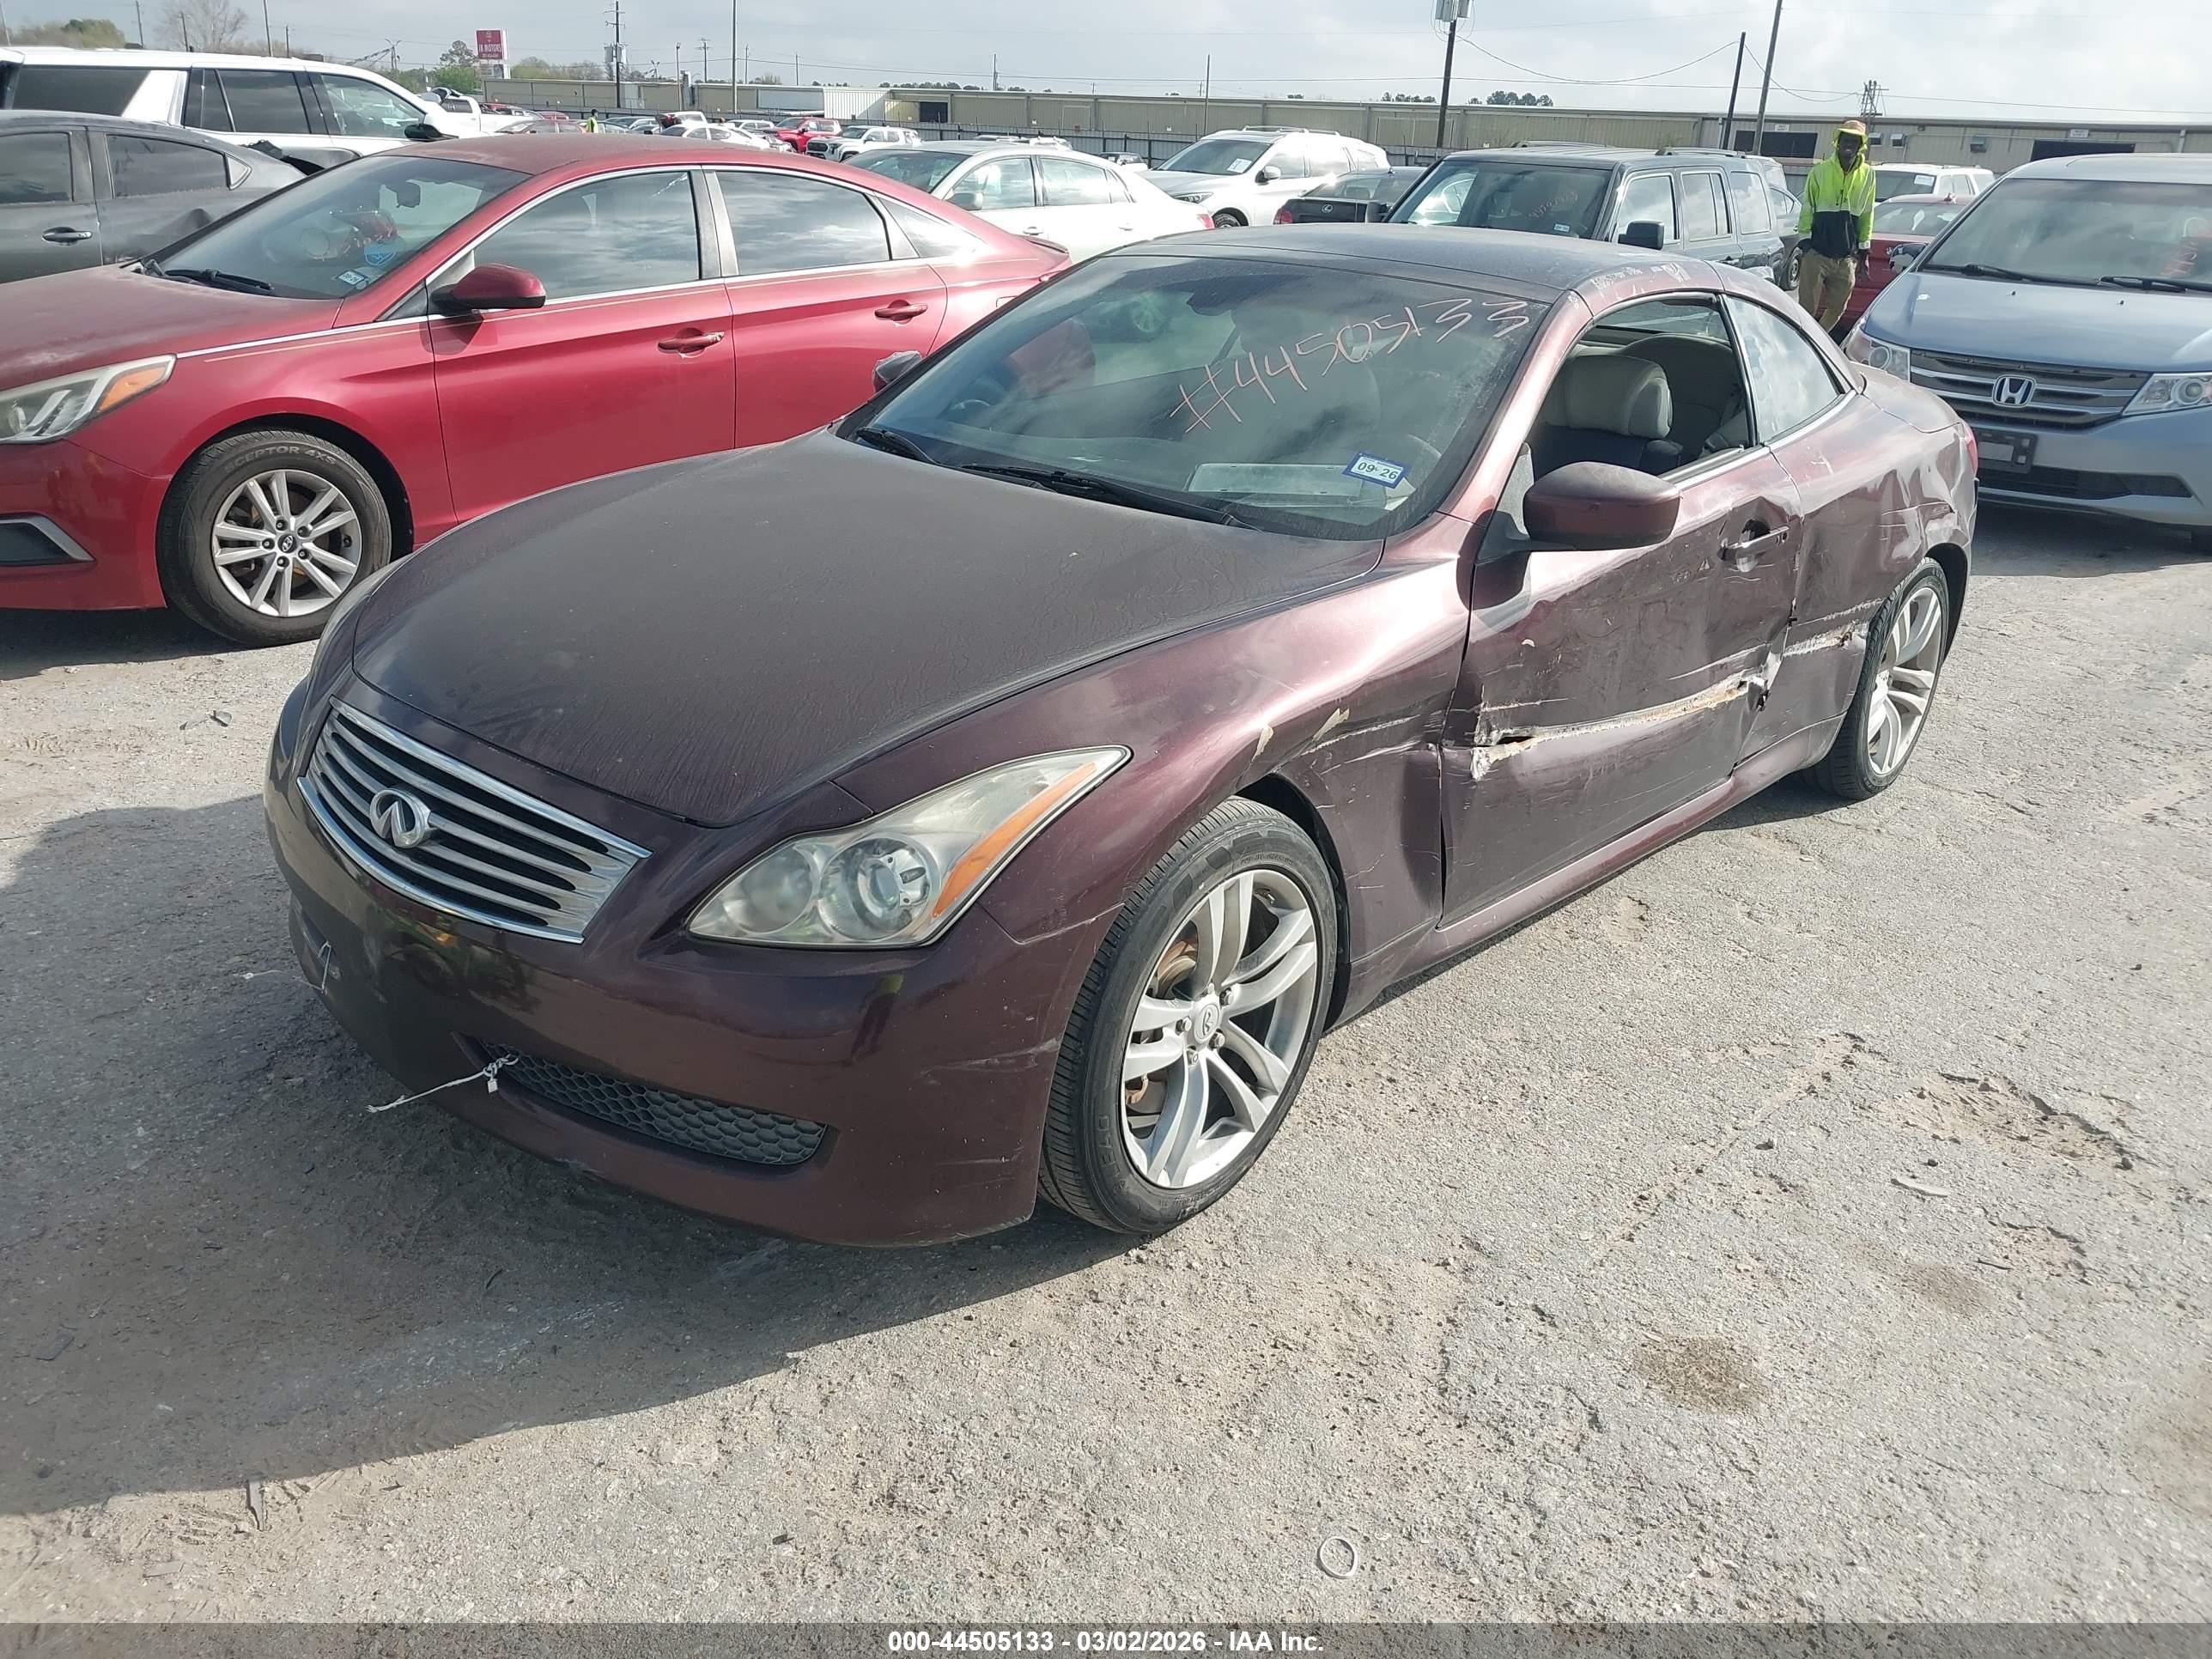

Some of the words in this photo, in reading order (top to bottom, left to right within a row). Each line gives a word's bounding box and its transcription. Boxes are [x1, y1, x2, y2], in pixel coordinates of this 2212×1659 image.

[1170, 298, 1529, 433] #44505133
[225, 446, 300, 472] SCEPTOR
[1358, 462, 1376, 473] 09
[1379, 468, 1399, 479] 26
